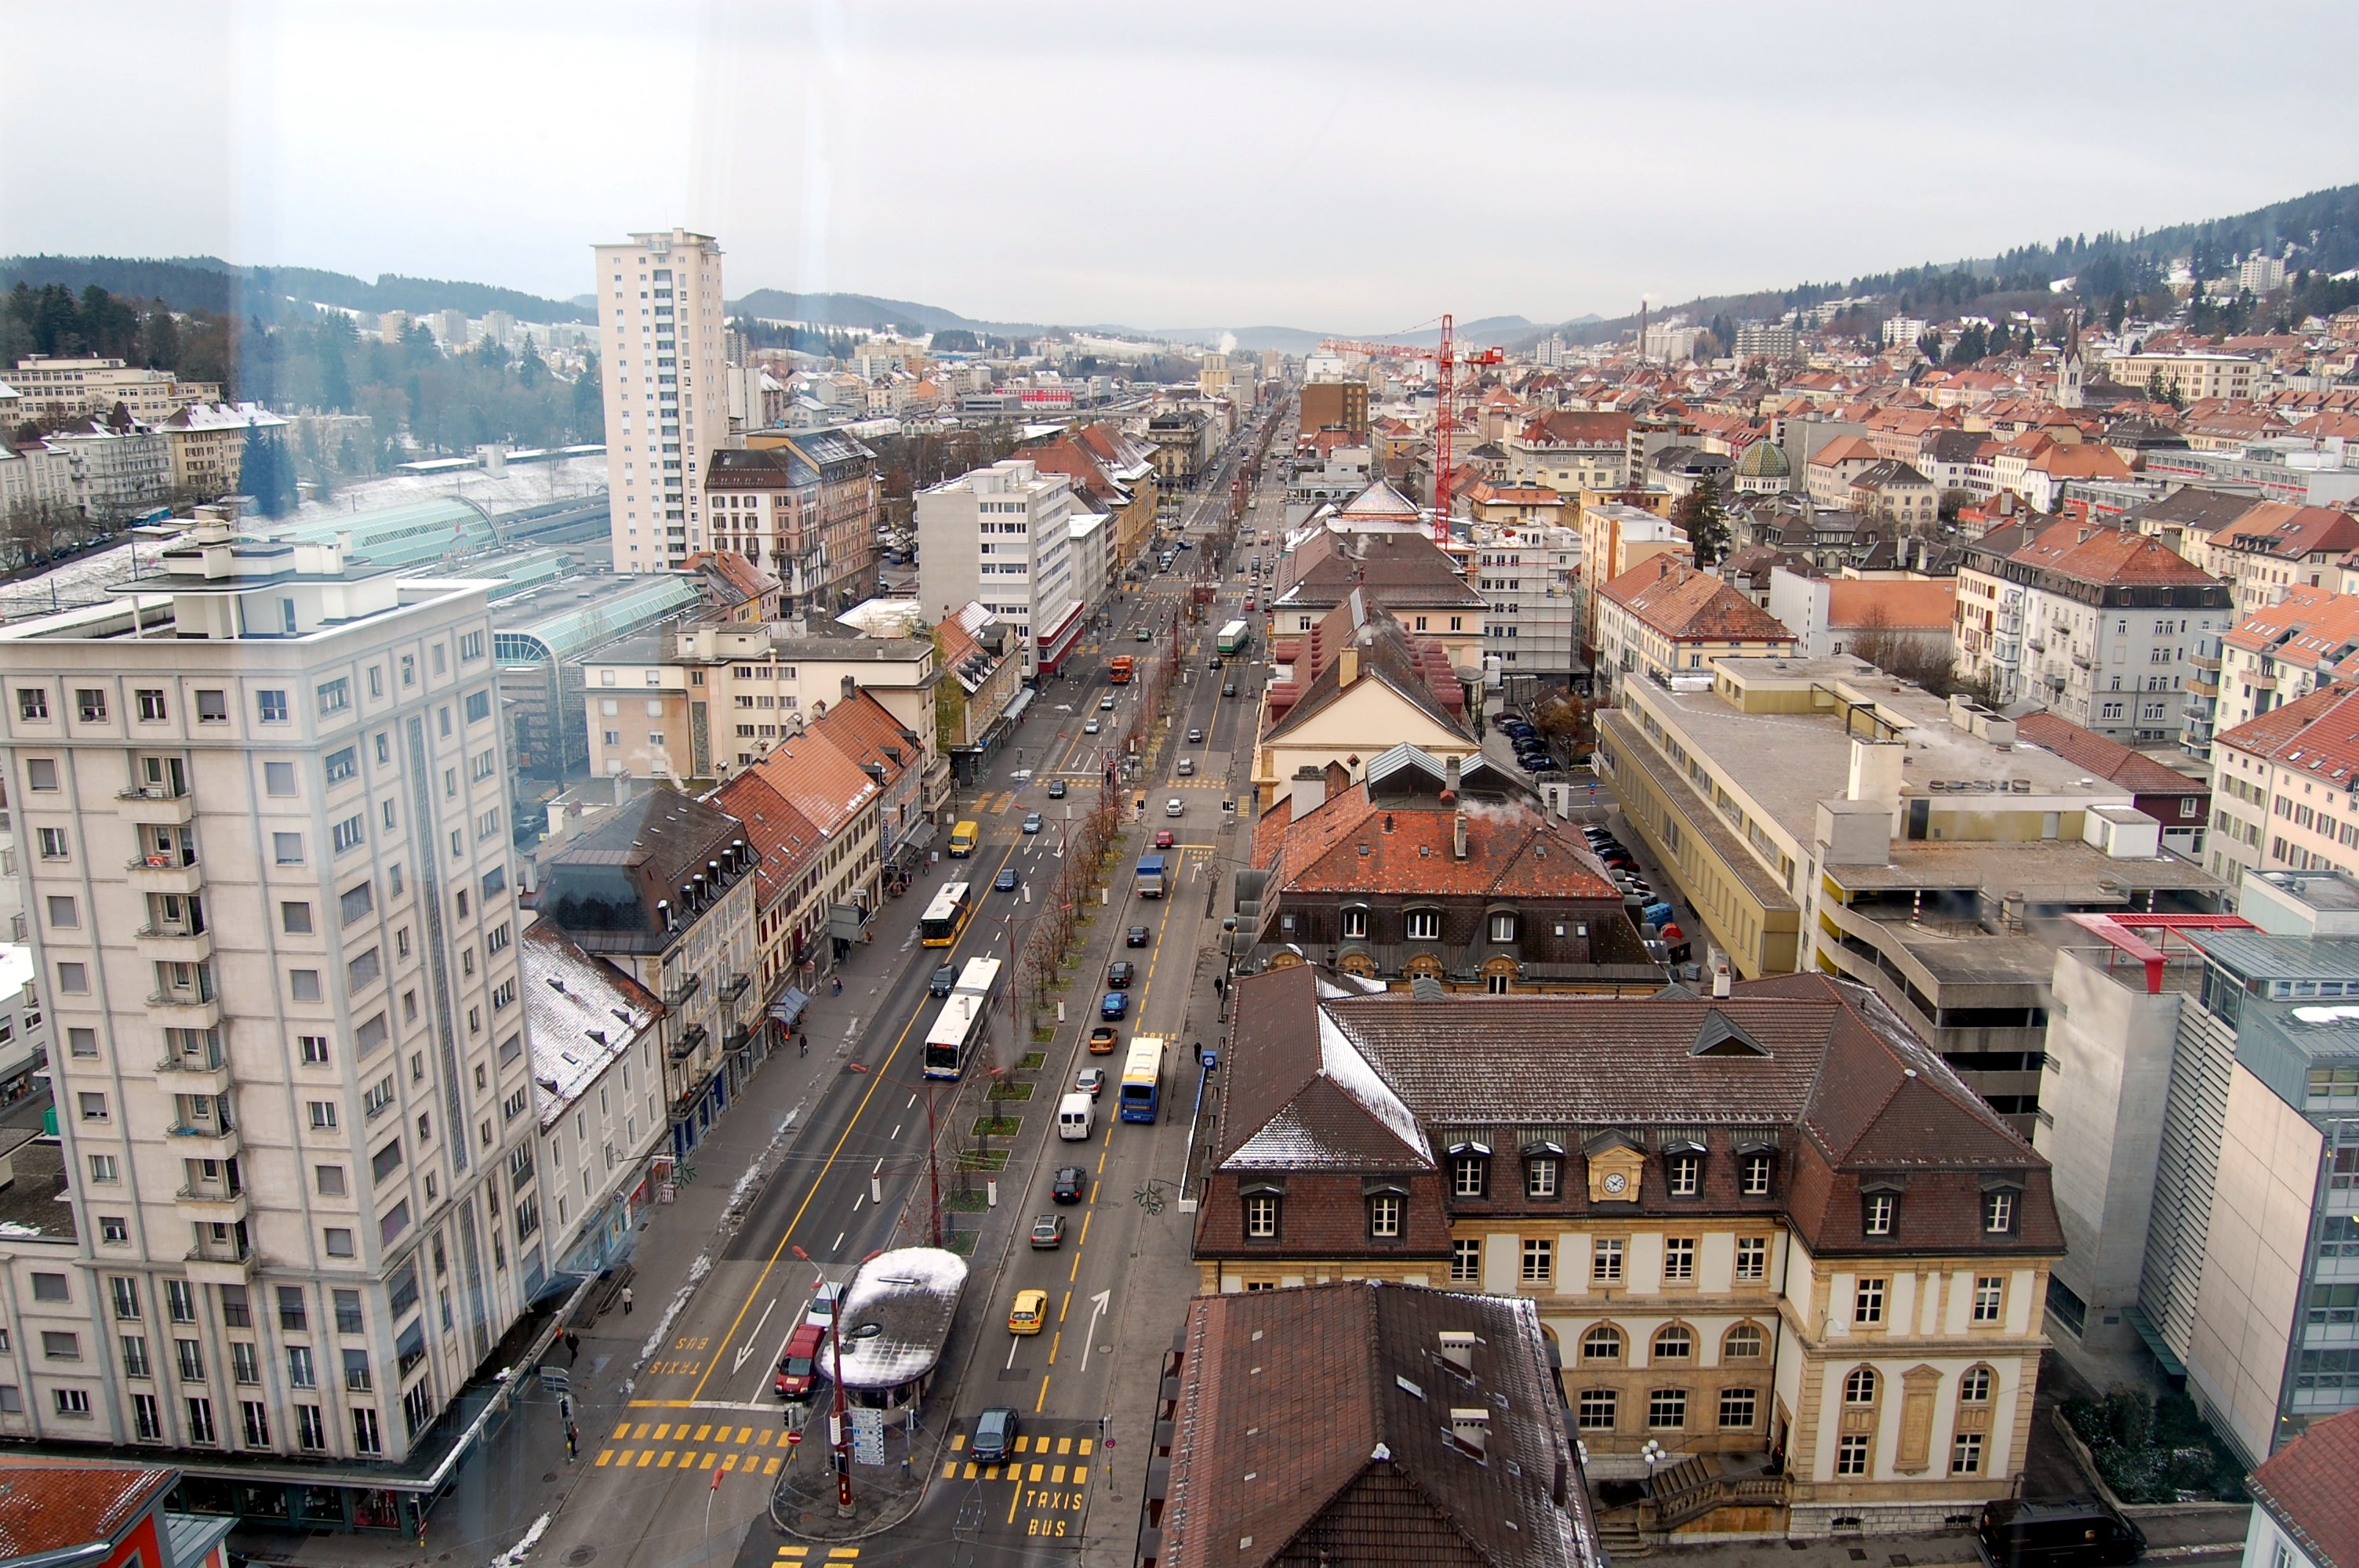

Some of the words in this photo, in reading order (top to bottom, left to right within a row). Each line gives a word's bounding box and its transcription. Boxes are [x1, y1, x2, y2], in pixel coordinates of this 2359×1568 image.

[675, 1336, 709, 1350] BUS
[649, 1360, 700, 1375] TAXIS
[1027, 1490, 1082, 1511] TAXIS
[1027, 1518, 1067, 1537] BUS
